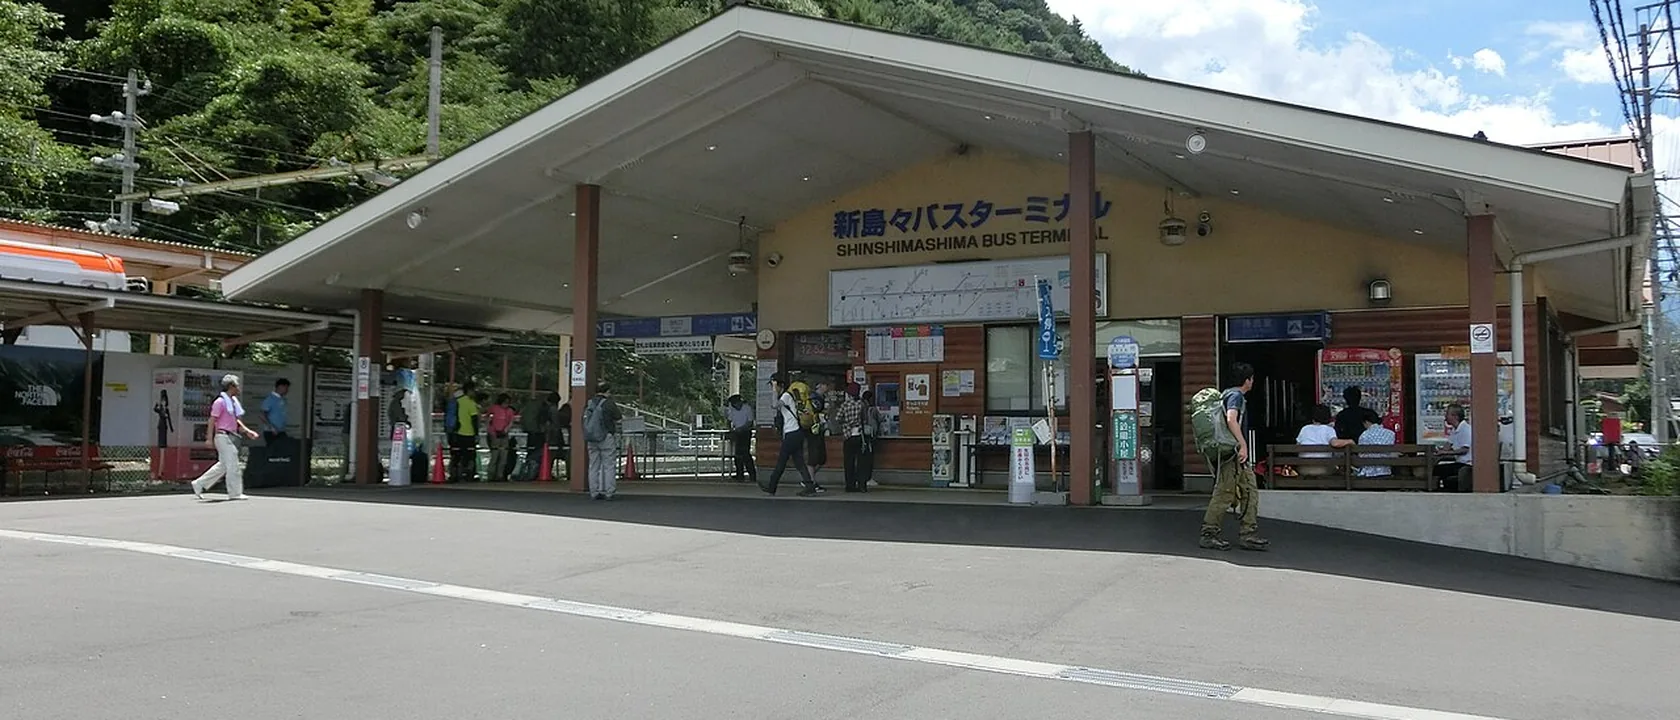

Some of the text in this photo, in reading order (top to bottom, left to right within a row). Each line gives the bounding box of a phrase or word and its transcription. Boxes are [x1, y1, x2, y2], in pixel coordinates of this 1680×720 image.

[836, 226, 1109, 257] SHINSHIMASHIMA BUS TERMIL
[27, 384, 44, 392] THE
[14, 390, 44, 399] NORTH
[21, 397, 44, 406] FACE
